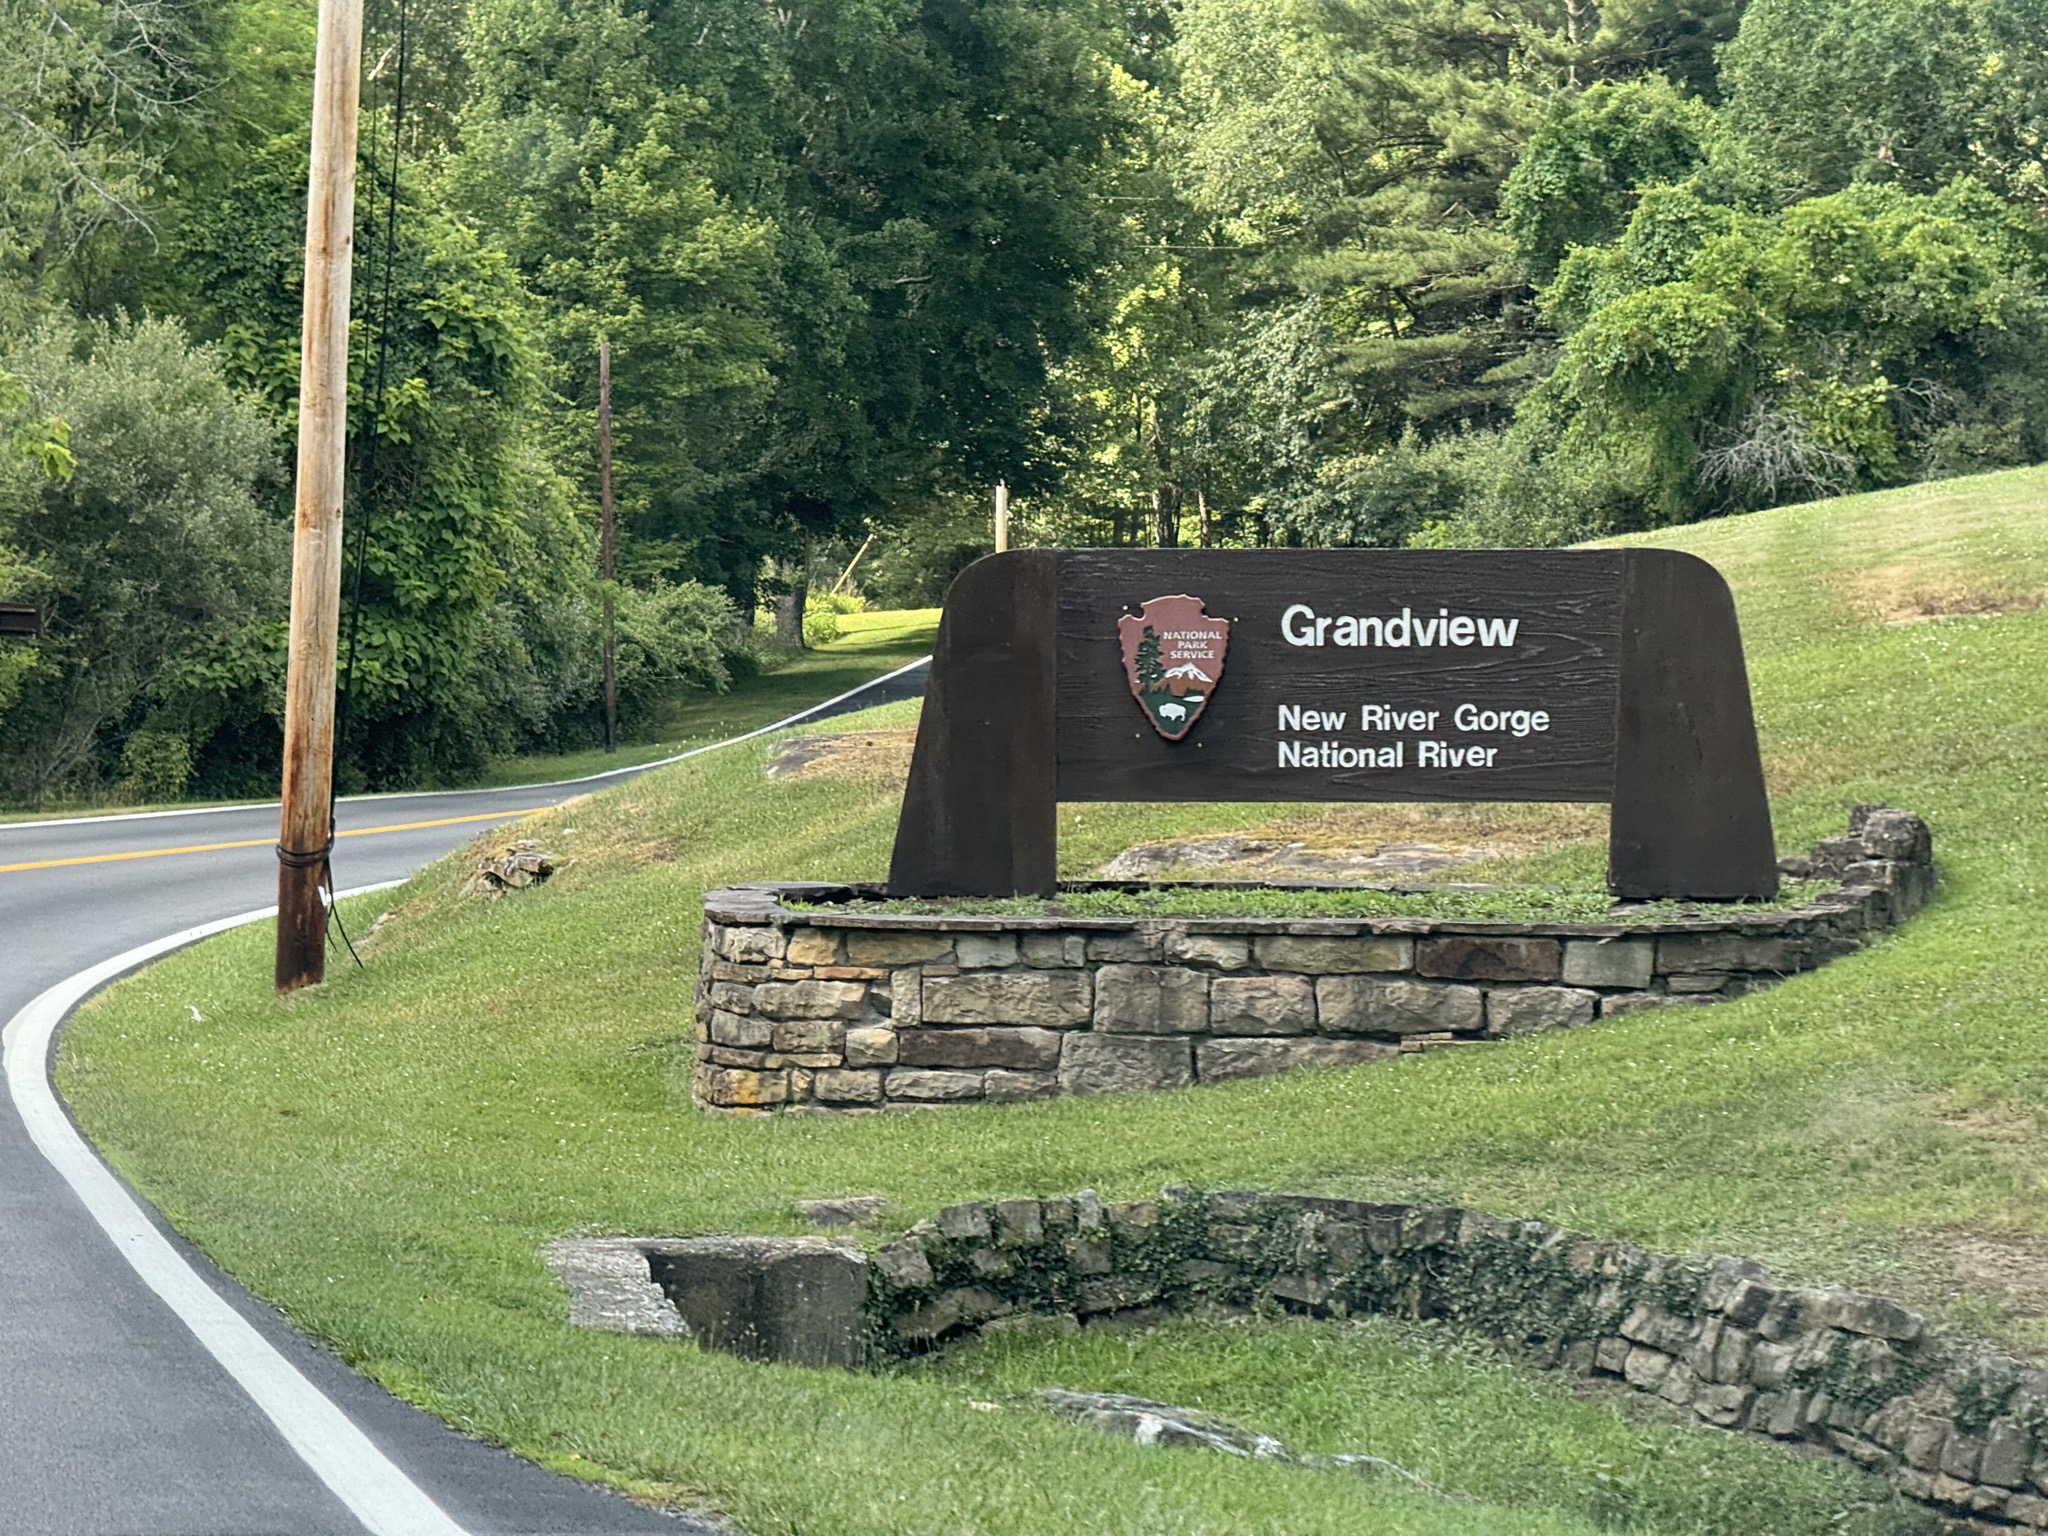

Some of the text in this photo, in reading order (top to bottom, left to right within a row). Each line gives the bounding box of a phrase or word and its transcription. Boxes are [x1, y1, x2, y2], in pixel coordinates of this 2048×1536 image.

[1281, 604, 1519, 648] Grandview
[1163, 631, 1222, 640] NATIONAL
[1178, 640, 1208, 649] PARK
[1170, 650, 1214, 659] SERVICE
[1278, 703, 1550, 737] New River Gorge
[1278, 741, 1498, 768] National River
